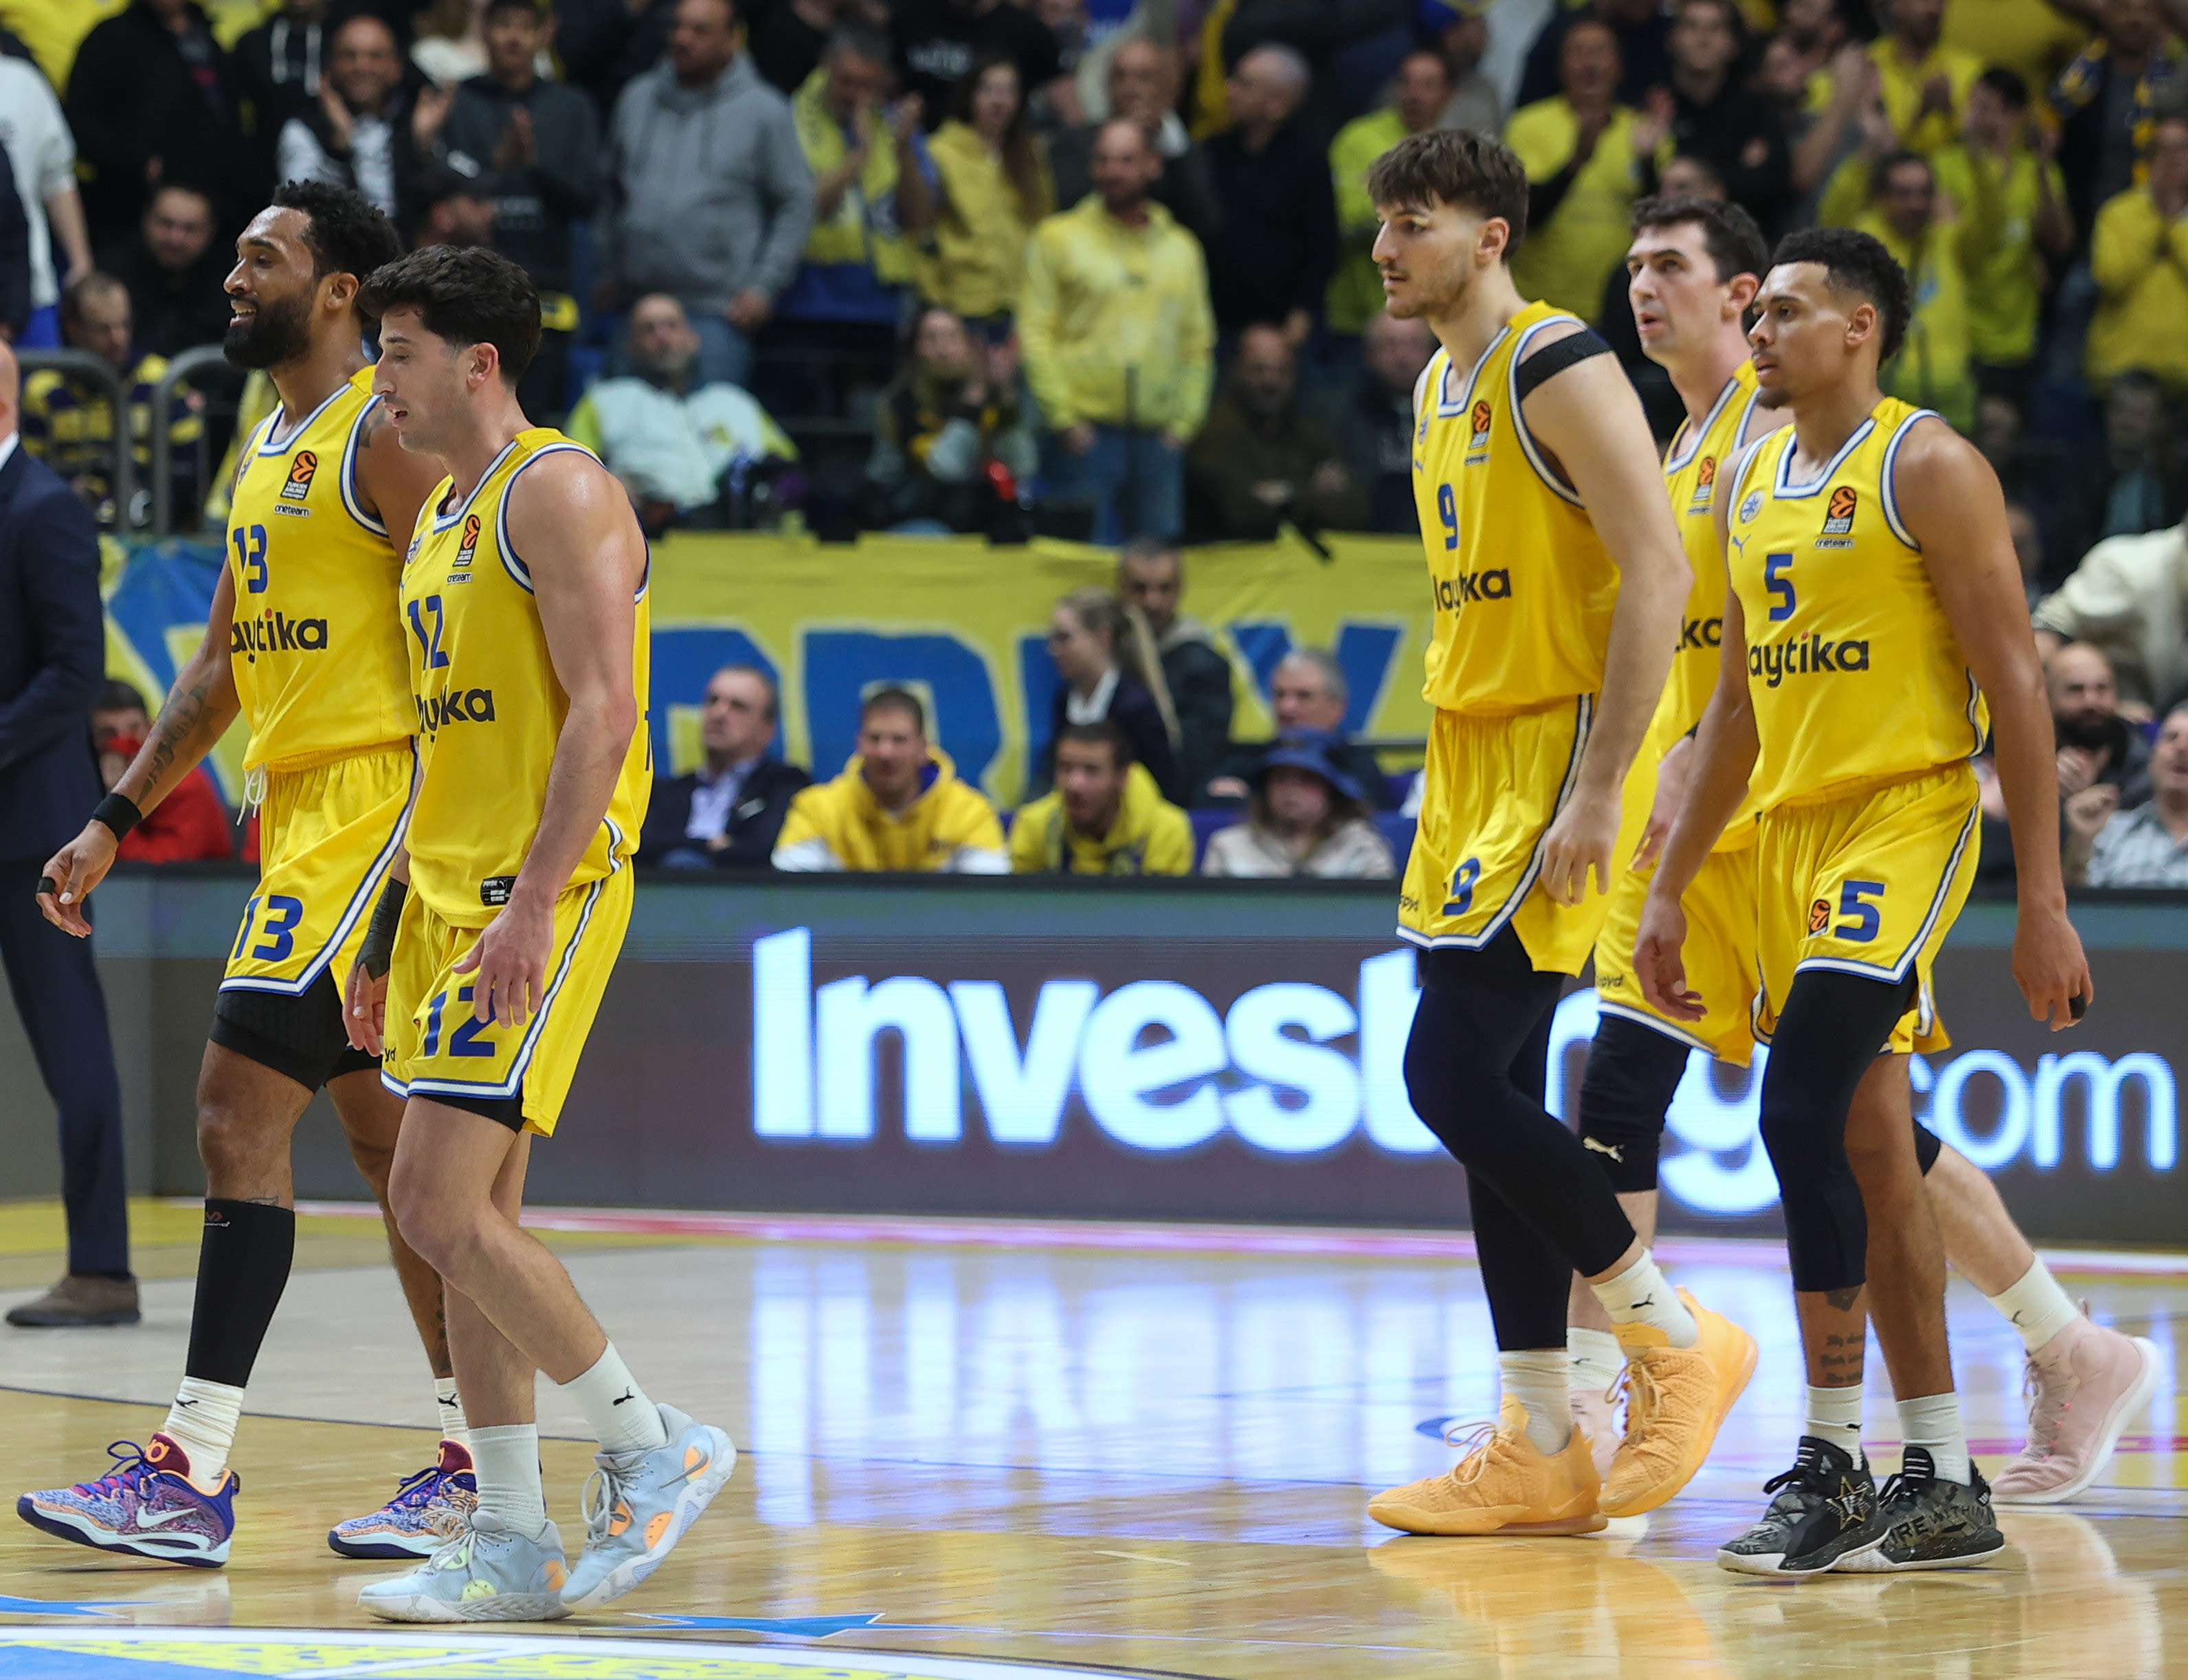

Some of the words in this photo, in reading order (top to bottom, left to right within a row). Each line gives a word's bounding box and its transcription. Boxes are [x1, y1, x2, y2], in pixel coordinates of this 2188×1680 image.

[1437, 482, 1458, 550] 9
[233, 524, 269, 594] 13
[1764, 553, 1796, 622] 5
[407, 594, 450, 671] 12
[1745, 630, 1870, 688] aytika
[1442, 857, 1480, 916] 9
[1834, 880, 1885, 943] 5
[234, 894, 303, 962] 13
[423, 985, 496, 1057] 12
